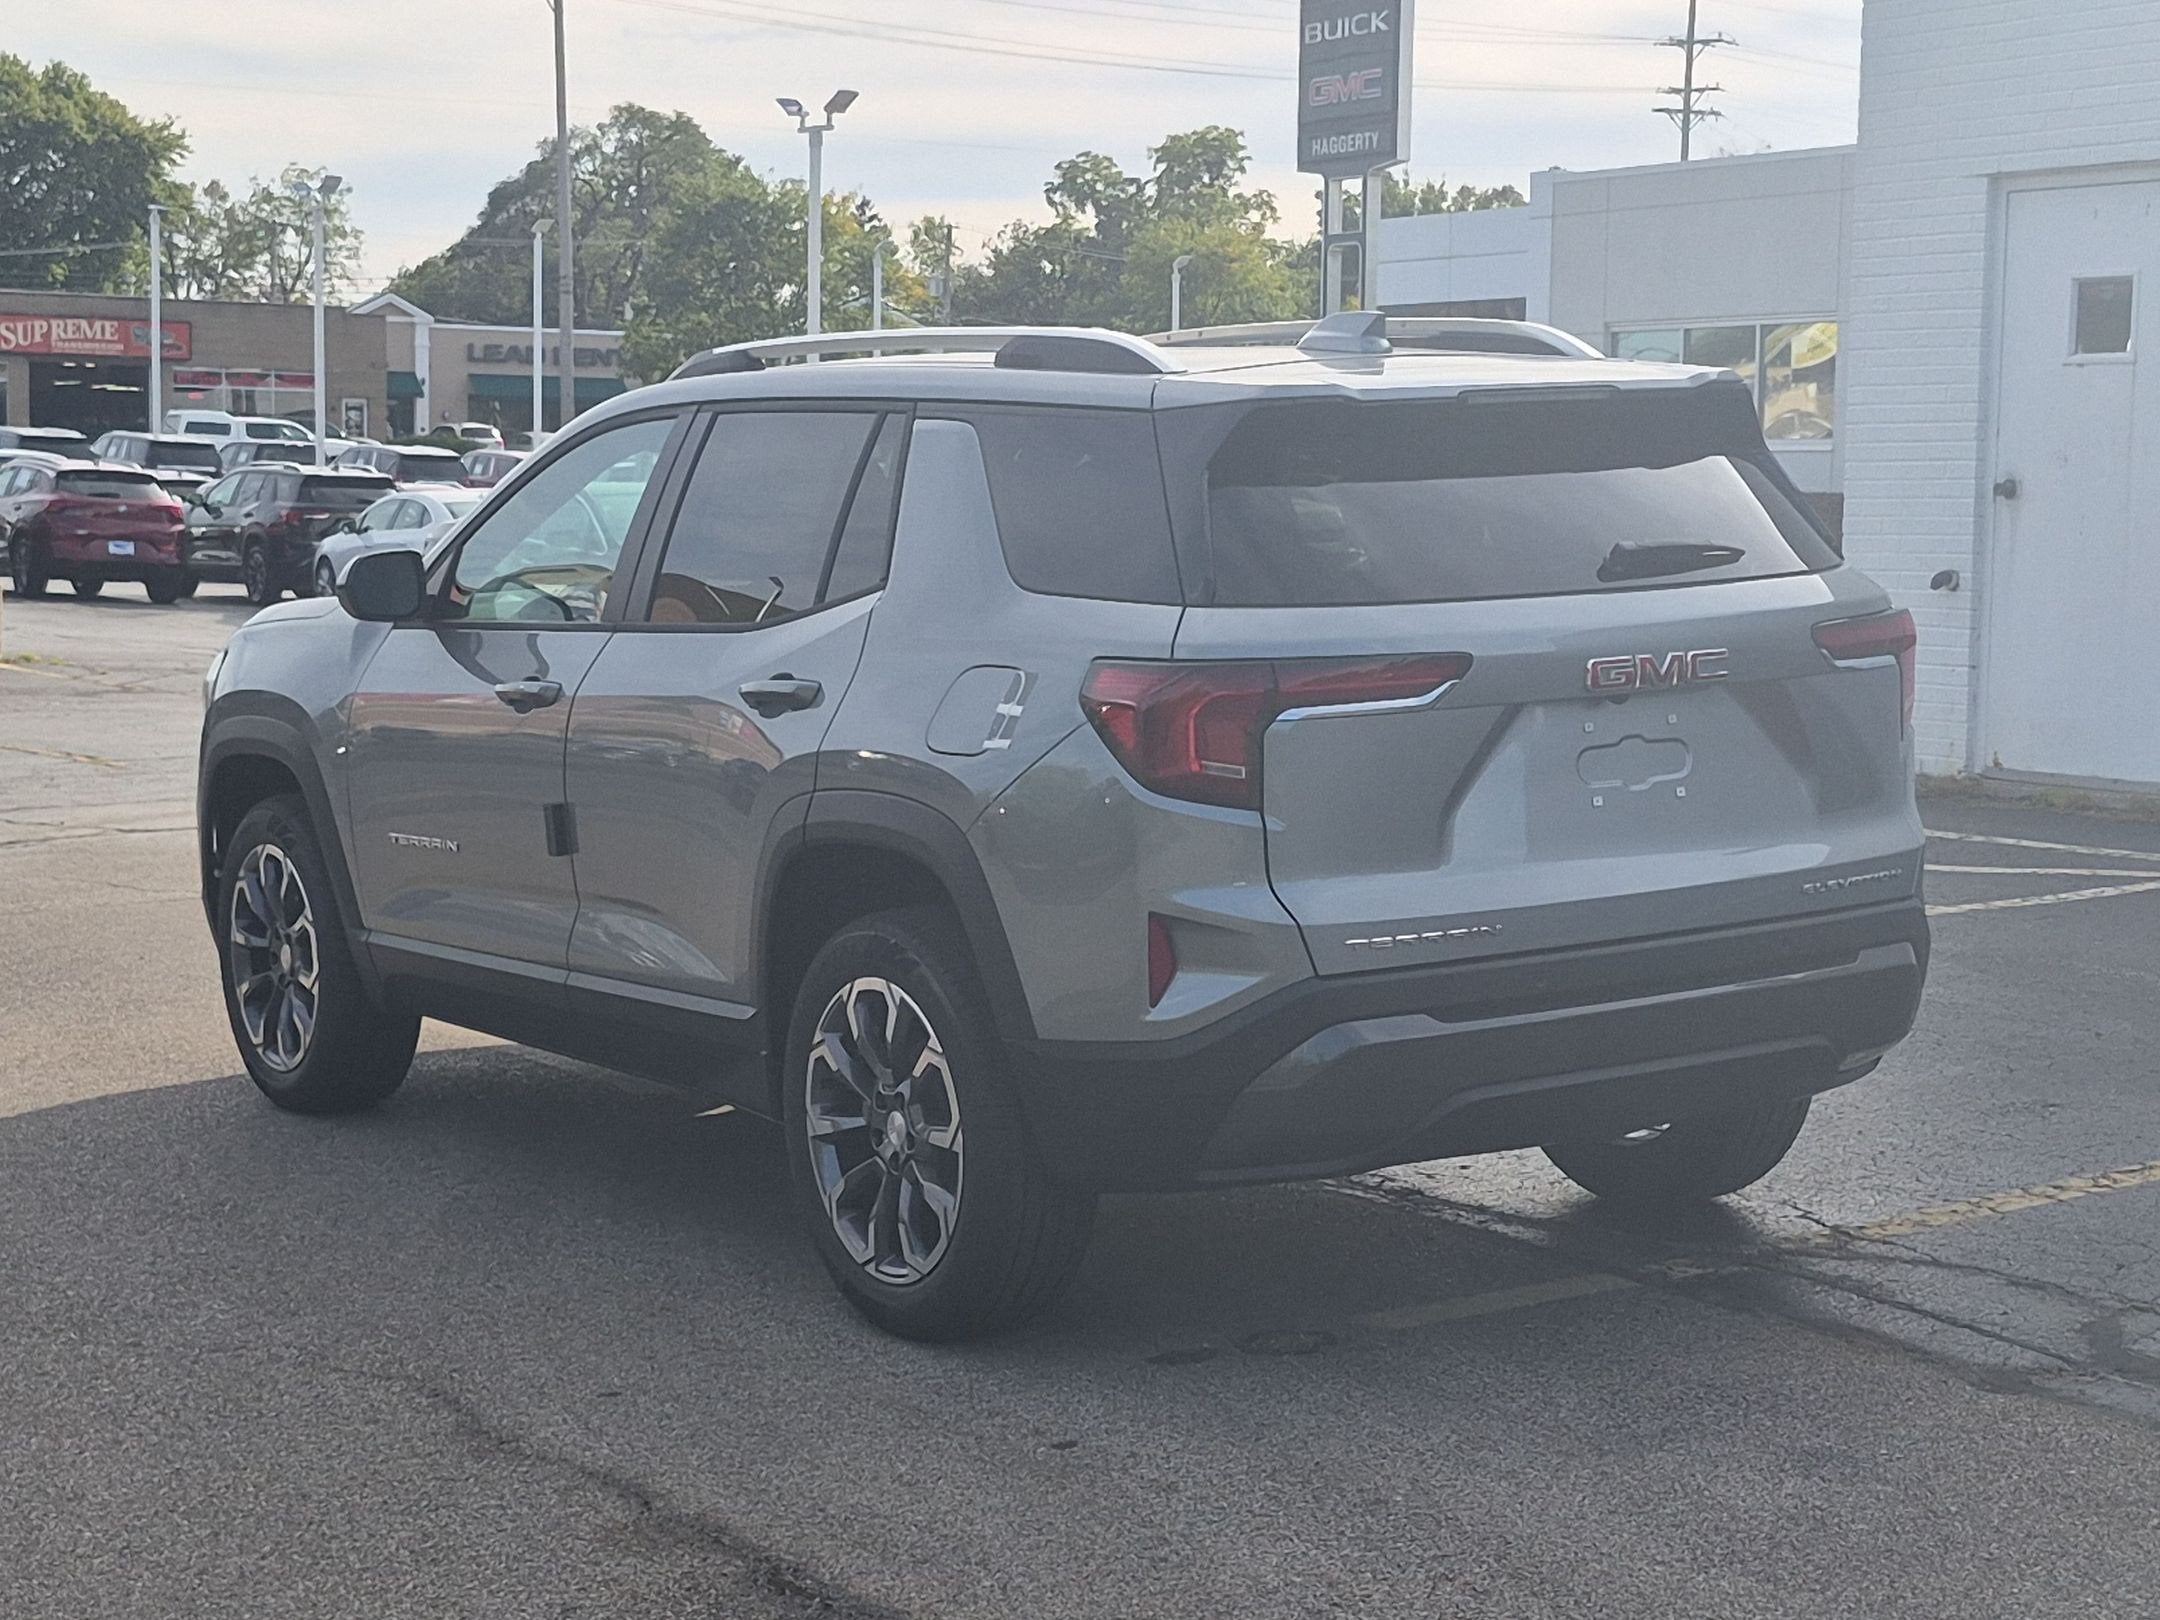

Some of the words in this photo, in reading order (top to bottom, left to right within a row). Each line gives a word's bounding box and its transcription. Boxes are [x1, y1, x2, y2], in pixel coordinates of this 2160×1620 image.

[1304, 10, 1389, 44] BUICK
[1309, 68, 1382, 107] GMC
[1312, 132, 1378, 156] HAGGERTY
[0, 318, 119, 350] SUPREME
[1587, 648, 1728, 691] GMC
[388, 832, 459, 852] TERRAIN
